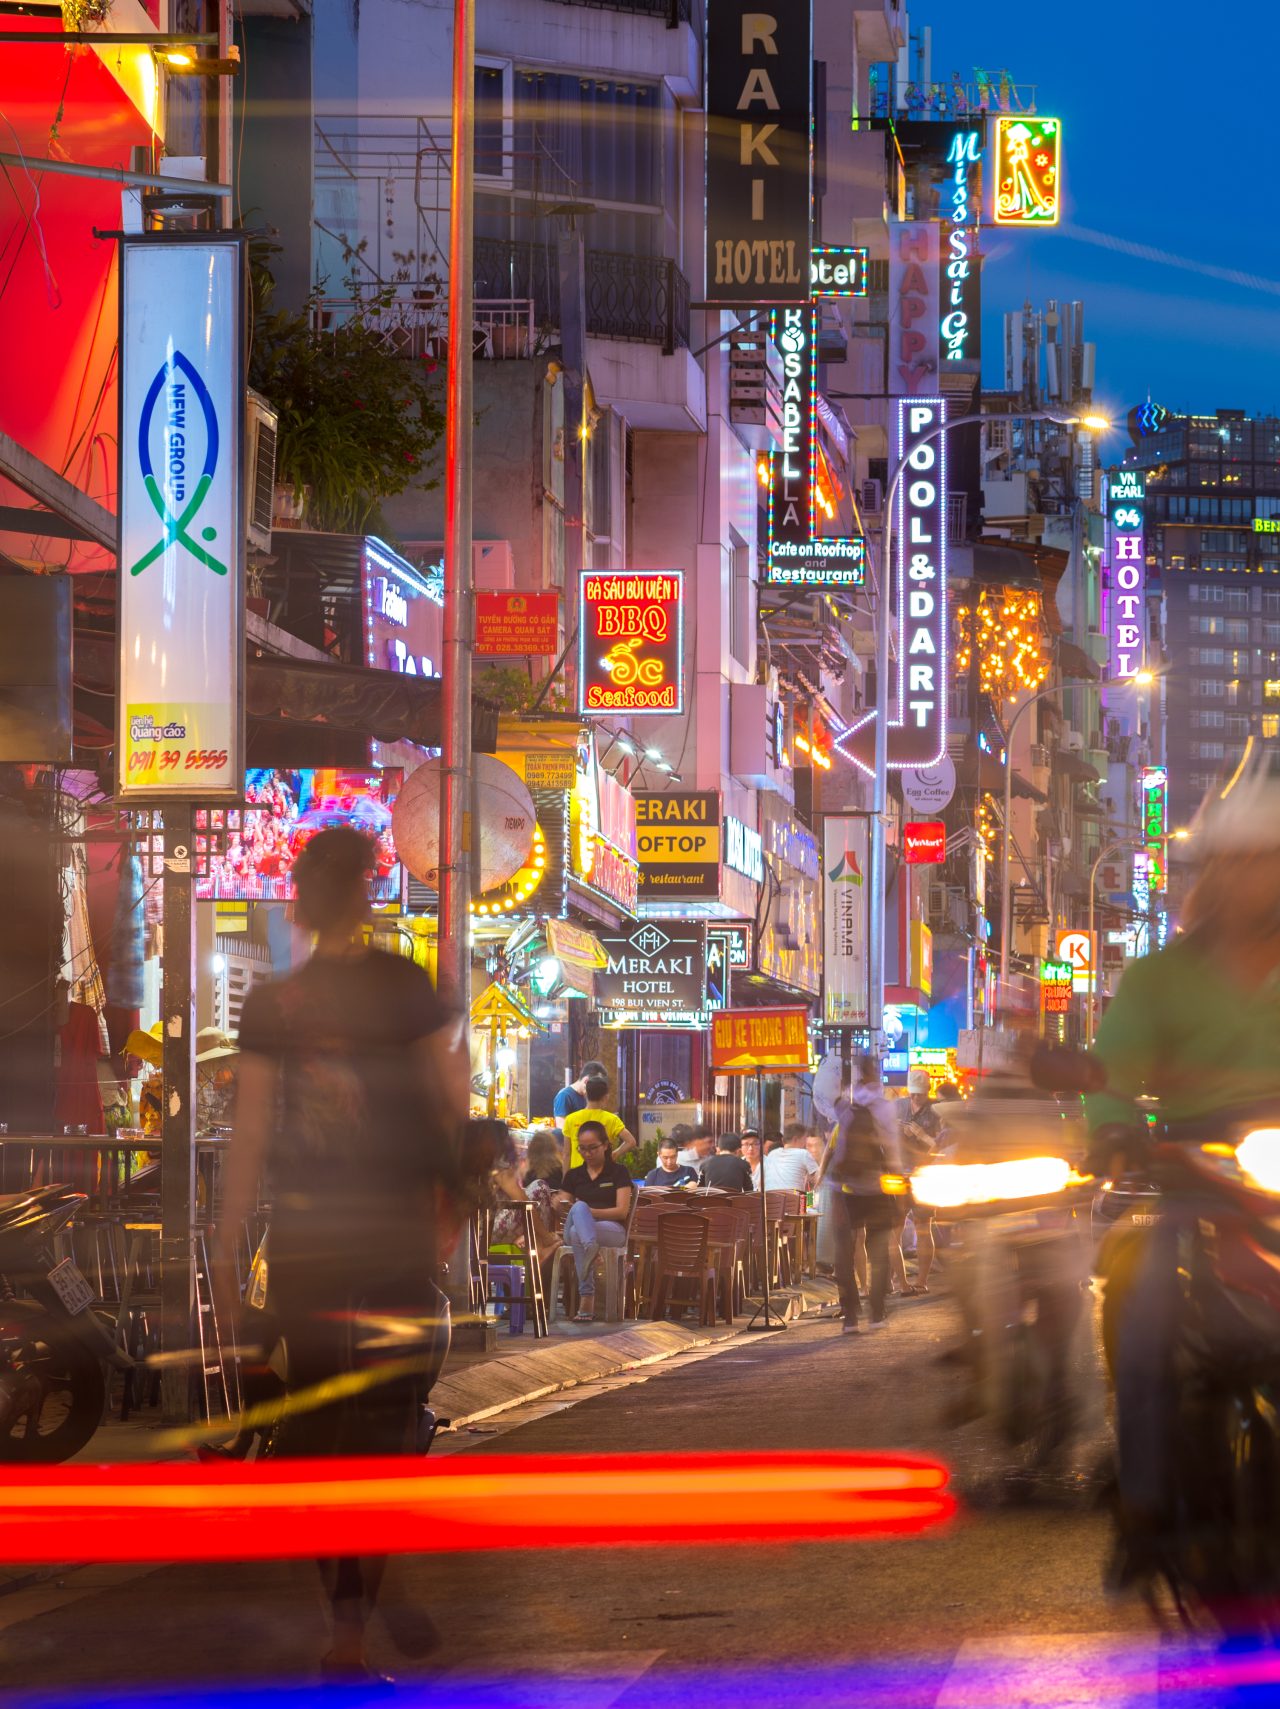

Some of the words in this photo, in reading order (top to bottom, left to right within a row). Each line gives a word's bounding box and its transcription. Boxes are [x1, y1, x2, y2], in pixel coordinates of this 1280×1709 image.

[947, 132, 981, 223] Miss
[714, 239, 801, 285] HOTEL
[898, 228, 929, 394] HAPPY
[168, 384, 185, 429] NEW
[169, 433, 185, 502] GROUP
[1119, 472, 1136, 485] VN
[1111, 486, 1144, 498] PEARL
[1114, 508, 1141, 527] 94
[1254, 518, 1280, 532] BEN
[772, 542, 797, 556] Cafe
[799, 546, 813, 556] on
[815, 541, 861, 560] Rooftop
[804, 557, 827, 569] and
[772, 567, 859, 581] Restaurant
[586, 576, 601, 600] BÀ
[603, 576, 625, 600] SÁU
[626, 576, 644, 600] BÙI
[645, 575, 671, 603] VIỆN
[1115, 536, 1142, 677] HOTEL
[482, 625, 513, 634] CAMERA
[514, 626, 535, 634] QUAN
[597, 605, 667, 641] BBQ
[588, 686, 675, 706] Seafood
[128, 750, 156, 771] 0911
[159, 750, 181, 770] 39
[184, 749, 228, 770] 5555
[906, 788, 922, 796] Egg
[923, 787, 950, 796] Coffee
[635, 799, 707, 820] ERAKI
[637, 836, 707, 852] OFTOP
[637, 872, 646, 886] &
[649, 873, 705, 884] restaurant
[840, 889, 853, 957] VINAMA
[1069, 942, 1088, 965] K
[605, 955, 693, 976] MERAKI
[623, 980, 675, 993] HOTEL
[612, 998, 625, 1008] 198
[627, 999, 644, 1008] BUI
[646, 998, 670, 1008] VIEN
[672, 999, 686, 1008] ST.
